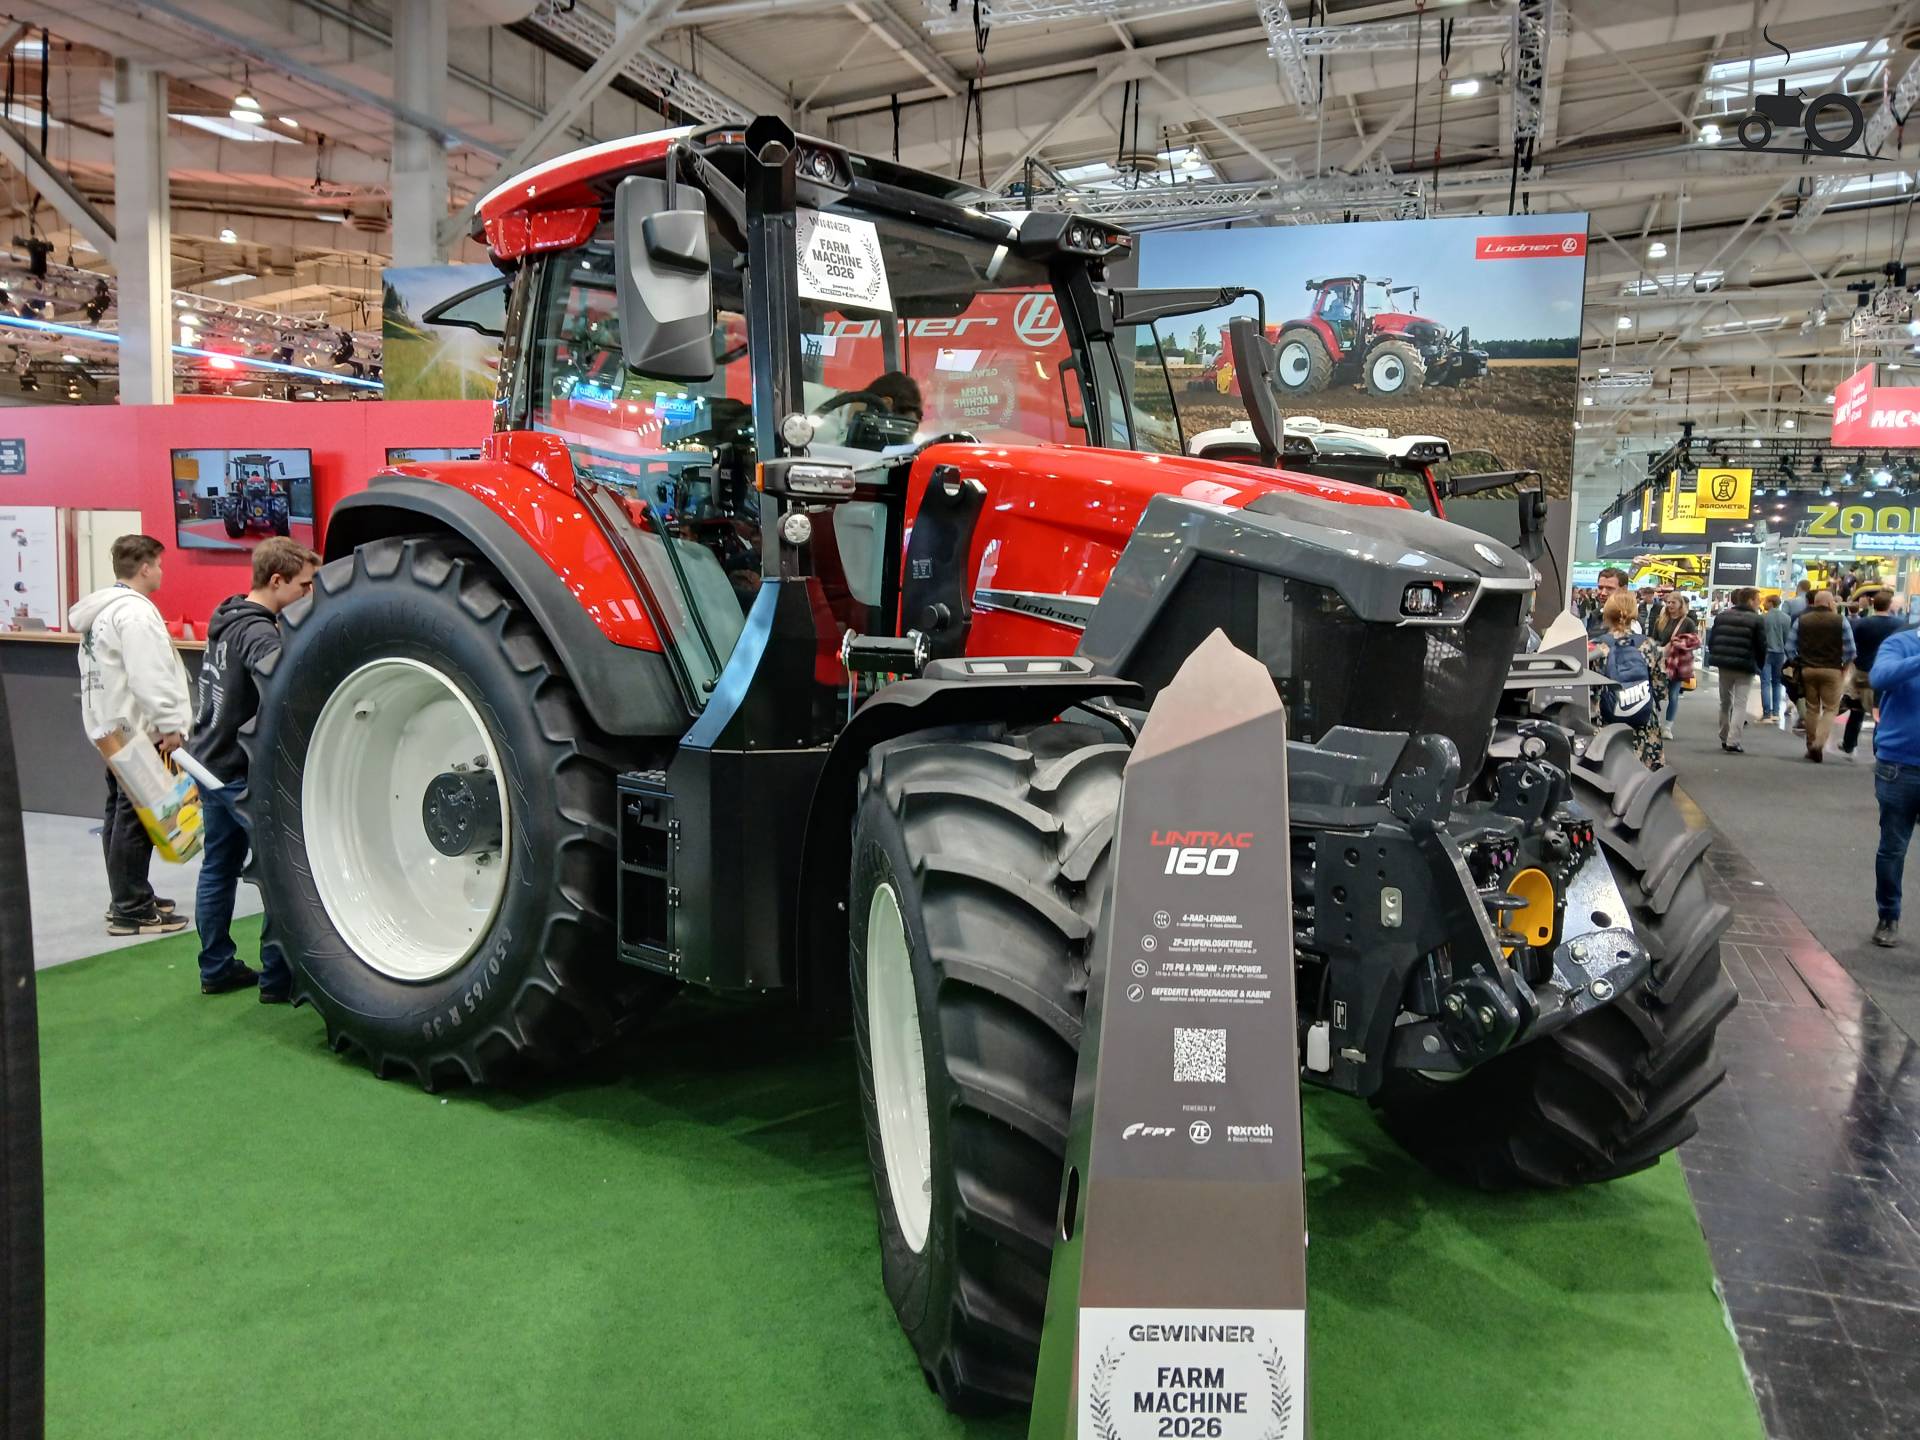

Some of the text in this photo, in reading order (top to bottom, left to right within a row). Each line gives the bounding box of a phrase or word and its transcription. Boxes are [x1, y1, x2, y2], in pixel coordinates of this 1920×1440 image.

[808, 216, 851, 234] WINNER
[820, 238, 850, 254] FARM
[1484, 244, 1558, 253] Lindner
[812, 249, 862, 269] MACHINE
[826, 264, 854, 280] 2026
[1012, 596, 1086, 623] Lindner
[1619, 680, 1649, 708] NIKE
[1150, 830, 1254, 848] LINTRAC
[1164, 847, 1240, 876] 160
[1182, 914, 1237, 923] 4-RAD-LENKUNG
[1173, 938, 1253, 949] ZF-STUFENLOSGETRIEBE
[1162, 963, 1174, 971] 175
[1175, 963, 1184, 971] PS
[1192, 964, 1205, 972] 700
[1206, 964, 1217, 972] NM
[1223, 965, 1262, 974] FPT-POWER
[1152, 987, 1188, 996] GEFEDERTE
[1190, 988, 1238, 998] VORDERACHSE
[1246, 990, 1272, 999] KABINE
[448, 1006, 462, 1026] R
[1142, 1127, 1176, 1137] FPT
[1190, 1123, 1210, 1141] ZF
[1228, 1124, 1273, 1137] rexroth
[1128, 1324, 1255, 1344] GEWINNER
[1157, 1366, 1225, 1389] FARM
[1133, 1392, 1248, 1414] MACHINE
[1158, 1416, 1222, 1438] 2026
